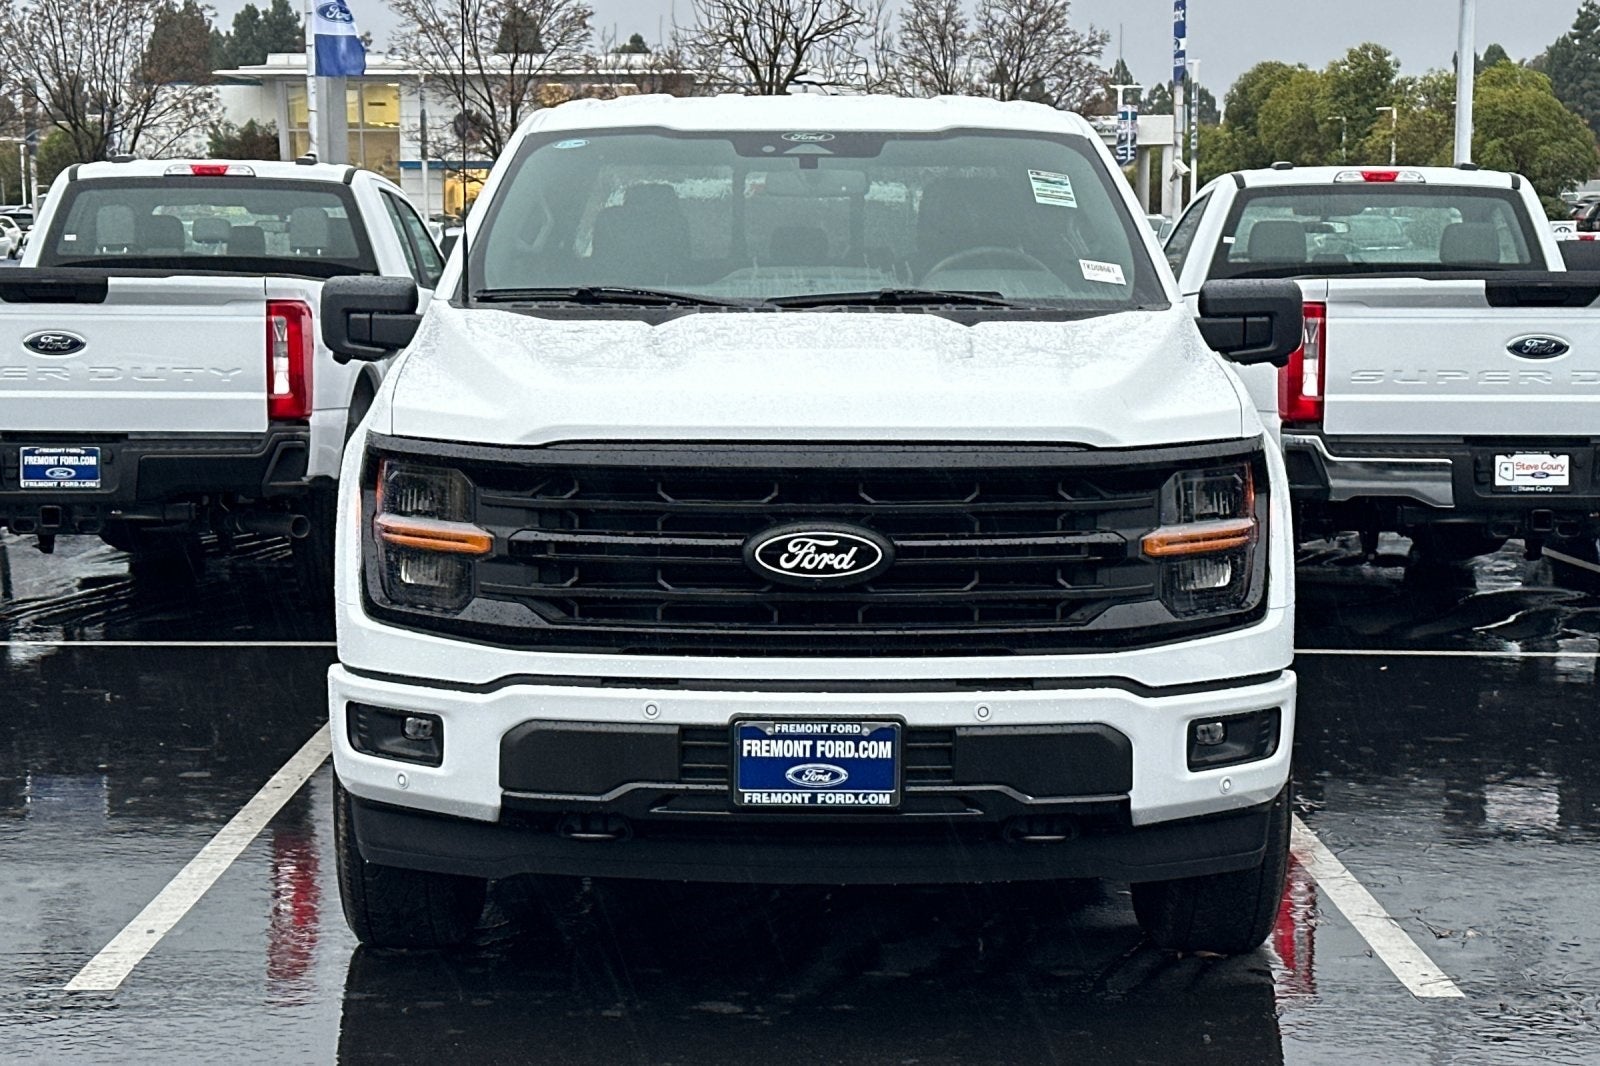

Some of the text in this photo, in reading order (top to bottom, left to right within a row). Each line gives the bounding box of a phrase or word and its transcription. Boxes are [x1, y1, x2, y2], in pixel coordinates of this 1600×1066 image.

[37, 334, 72, 350] Ford
[1520, 338, 1556, 354] Ford
[88, 366, 243, 382] DUTY
[1350, 369, 1552, 384] SUPER
[24, 455, 97, 466] FREMONT FORD.COM
[1515, 461, 1566, 472] Steve Coury
[779, 537, 859, 570] Ford
[774, 723, 861, 734] FREMONT FORD
[742, 739, 892, 759] FREMONT FORD.COM
[801, 768, 832, 783] Ford
[743, 792, 891, 805] FREMONT FORD.COM
